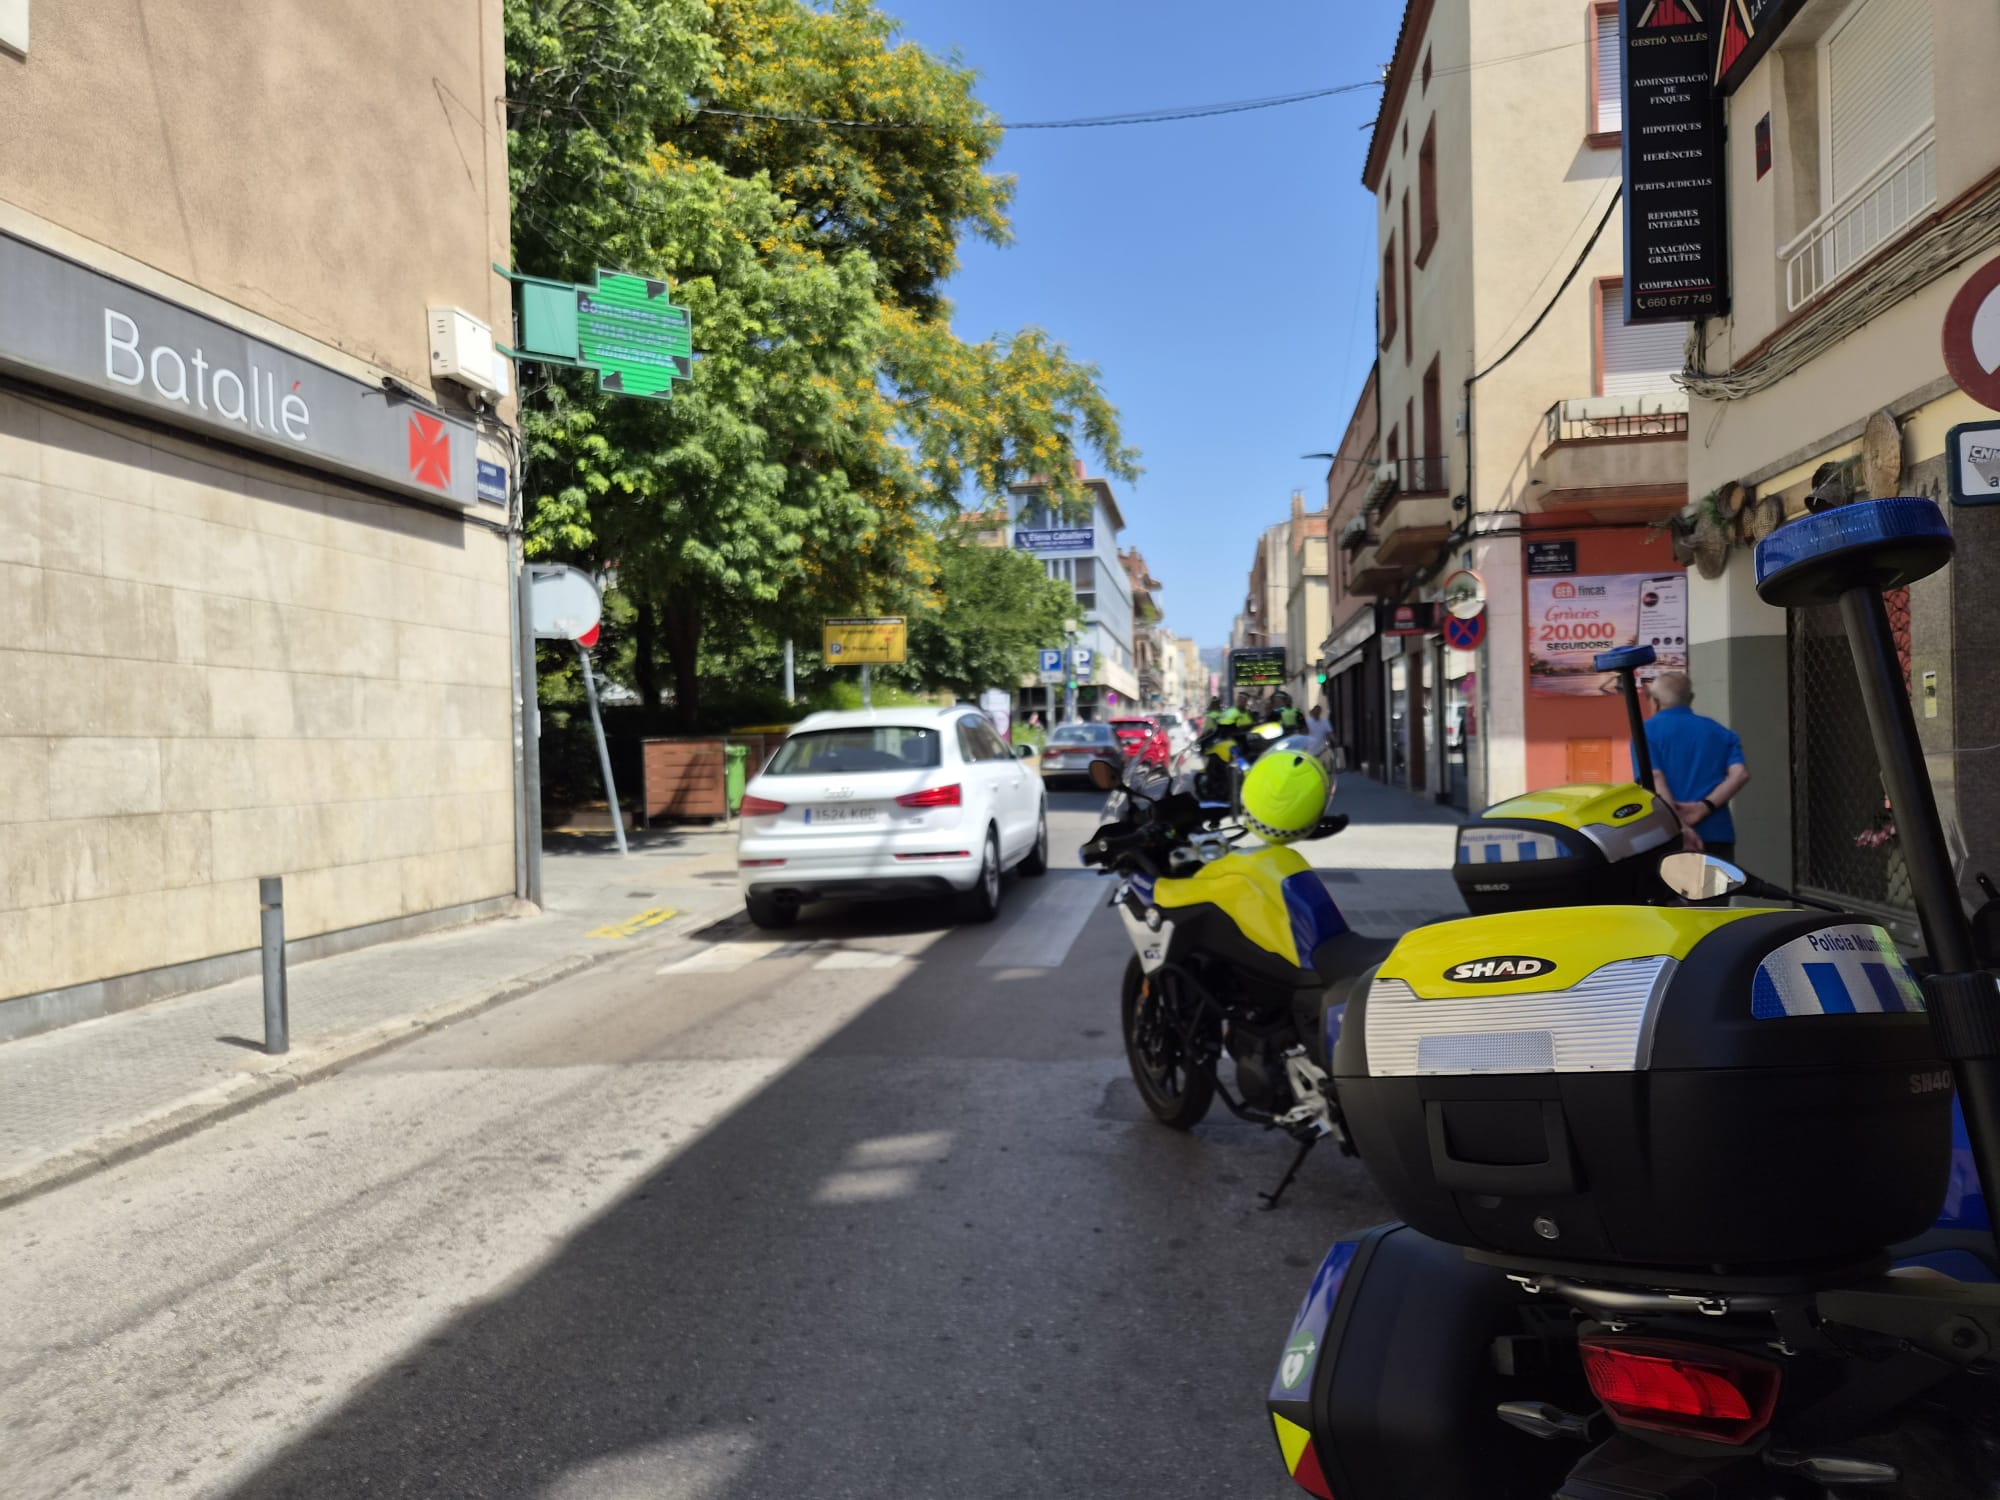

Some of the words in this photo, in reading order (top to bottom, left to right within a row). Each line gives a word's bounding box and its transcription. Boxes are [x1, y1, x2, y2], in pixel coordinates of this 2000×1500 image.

[1631, 35, 1667, 47] GESTIÓ
[1634, 72, 1708, 87] ADMINISTRACIÓ
[1663, 86, 1676, 94] DE
[1650, 94, 1691, 105] FINQUES
[1642, 122, 1702, 134] HIPOTEQUES
[1634, 182, 1666, 191] PERITS
[1666, 178, 1712, 189] JUDICIALS
[1647, 209, 1699, 221] REFORMES
[1648, 218, 1700, 230] INTEGRALS
[1639, 277, 1711, 290] COMPRAVENDA
[1647, 297, 1667, 308] 660
[1669, 295, 1689, 306] 677
[1692, 293, 1712, 304] 749
[105, 308, 310, 441] Batallé
[1578, 585, 1607, 596] fincas
[1540, 622, 1615, 641] 20.000
[1546, 640, 1614, 652] SEGUIDORS!
[1044, 652, 1059, 670] P
[1453, 960, 1542, 979] SHAD
[1910, 1071, 1950, 1093] SH40
